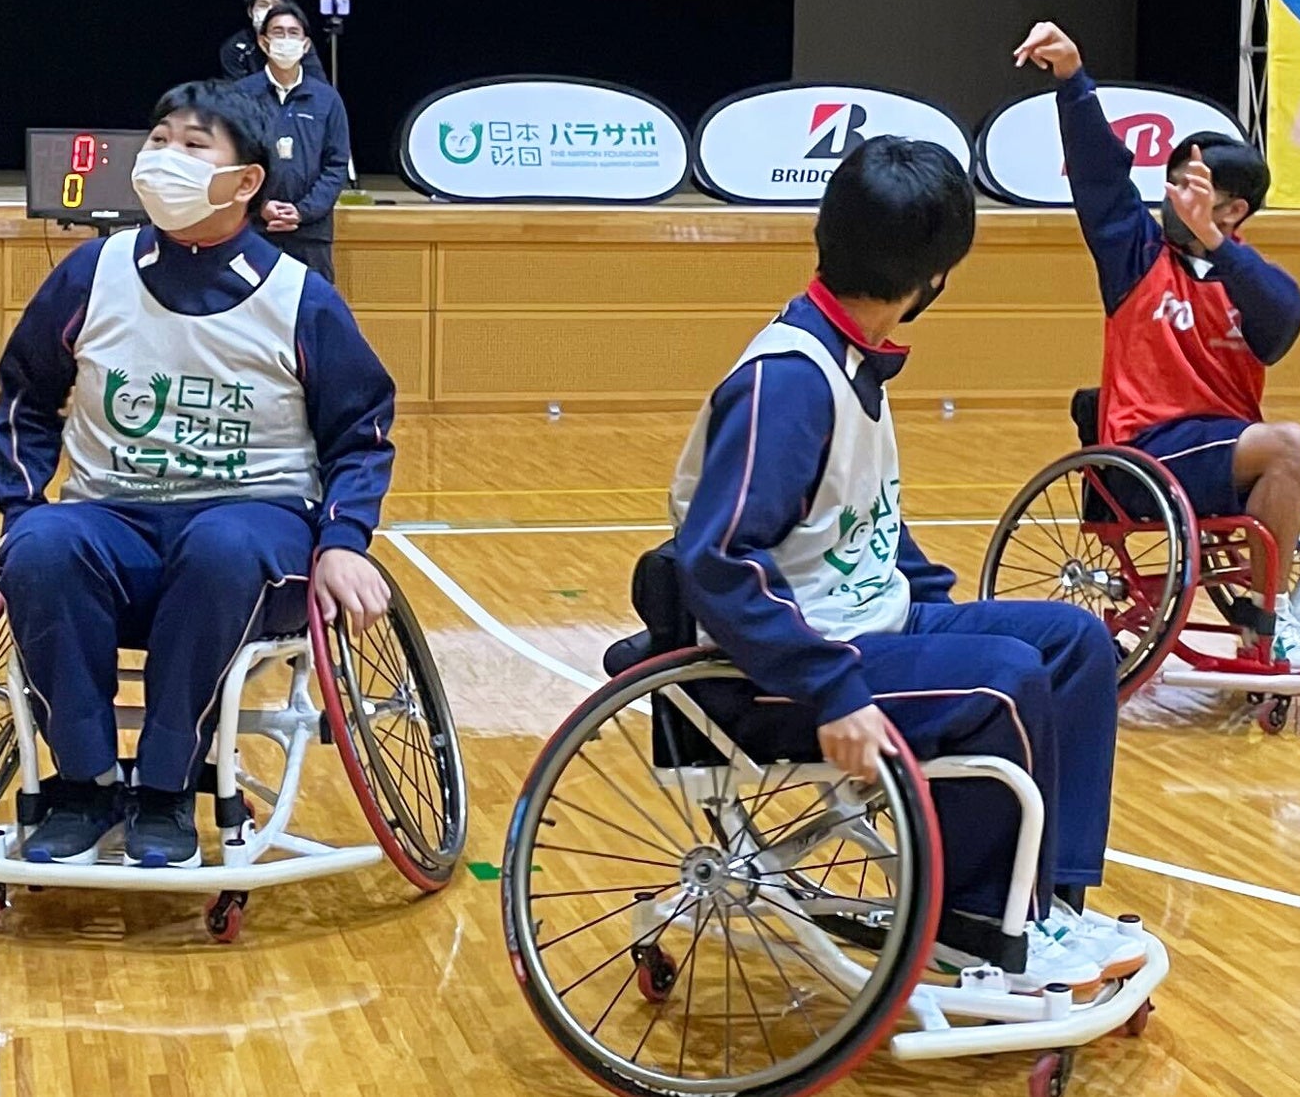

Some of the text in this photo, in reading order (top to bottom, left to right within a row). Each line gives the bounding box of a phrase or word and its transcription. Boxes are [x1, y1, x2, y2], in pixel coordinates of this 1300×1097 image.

[488, 121, 540, 143] 日本
[550, 121, 657, 146] パラサポ
[62, 173, 84, 208] 0
[177, 375, 255, 413] 日本
[110, 445, 249, 480] パラサポ
